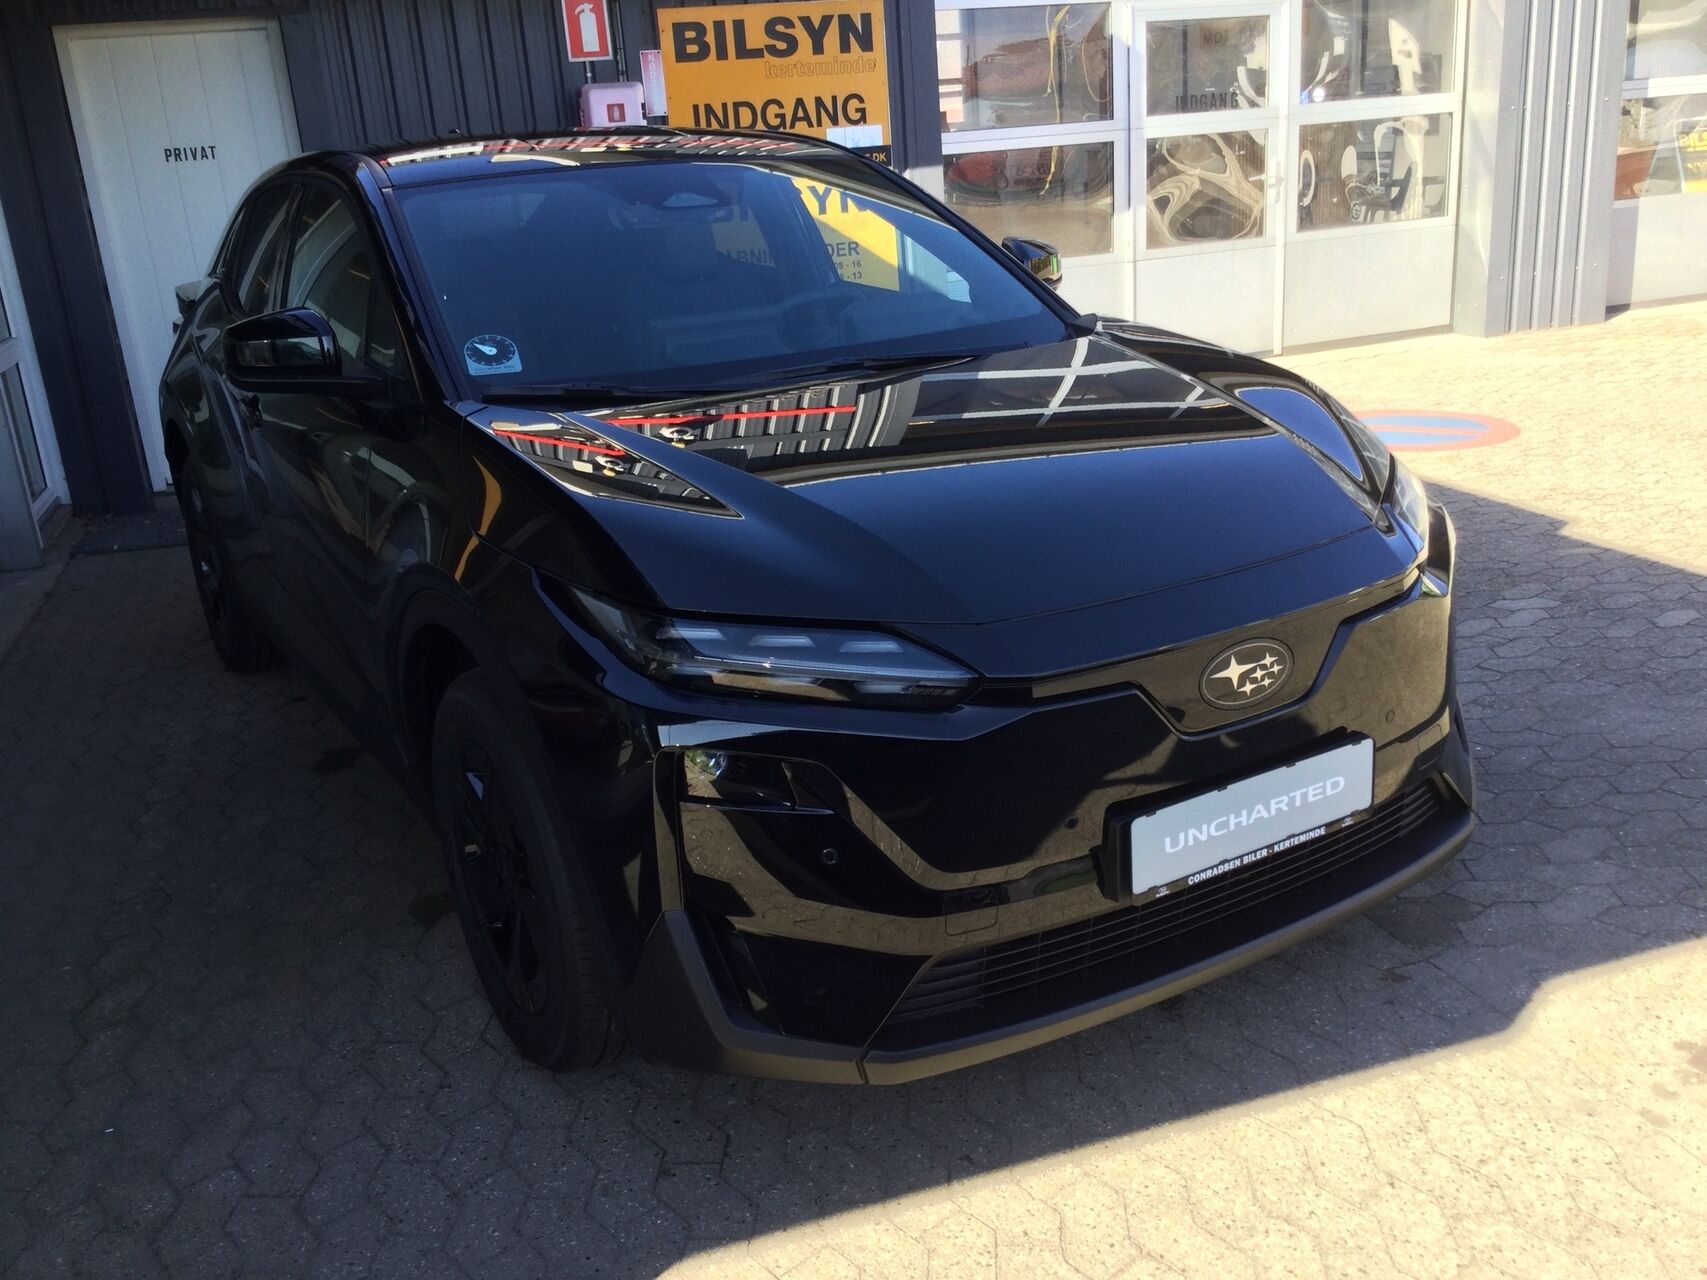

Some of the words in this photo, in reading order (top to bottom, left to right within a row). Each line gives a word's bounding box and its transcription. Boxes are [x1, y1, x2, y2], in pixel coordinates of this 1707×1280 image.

[671, 12, 874, 63] BILSYN
[764, 57, 877, 79] kerteminde
[692, 93, 867, 130] INDGANG
[164, 145, 216, 163] PRIVAT
[1164, 776, 1346, 853] UNCHARTED
[1187, 858, 1241, 885] CONRADSEN
[1243, 848, 1268, 864] BILER
[1273, 826, 1326, 853] KERTEMINDE
